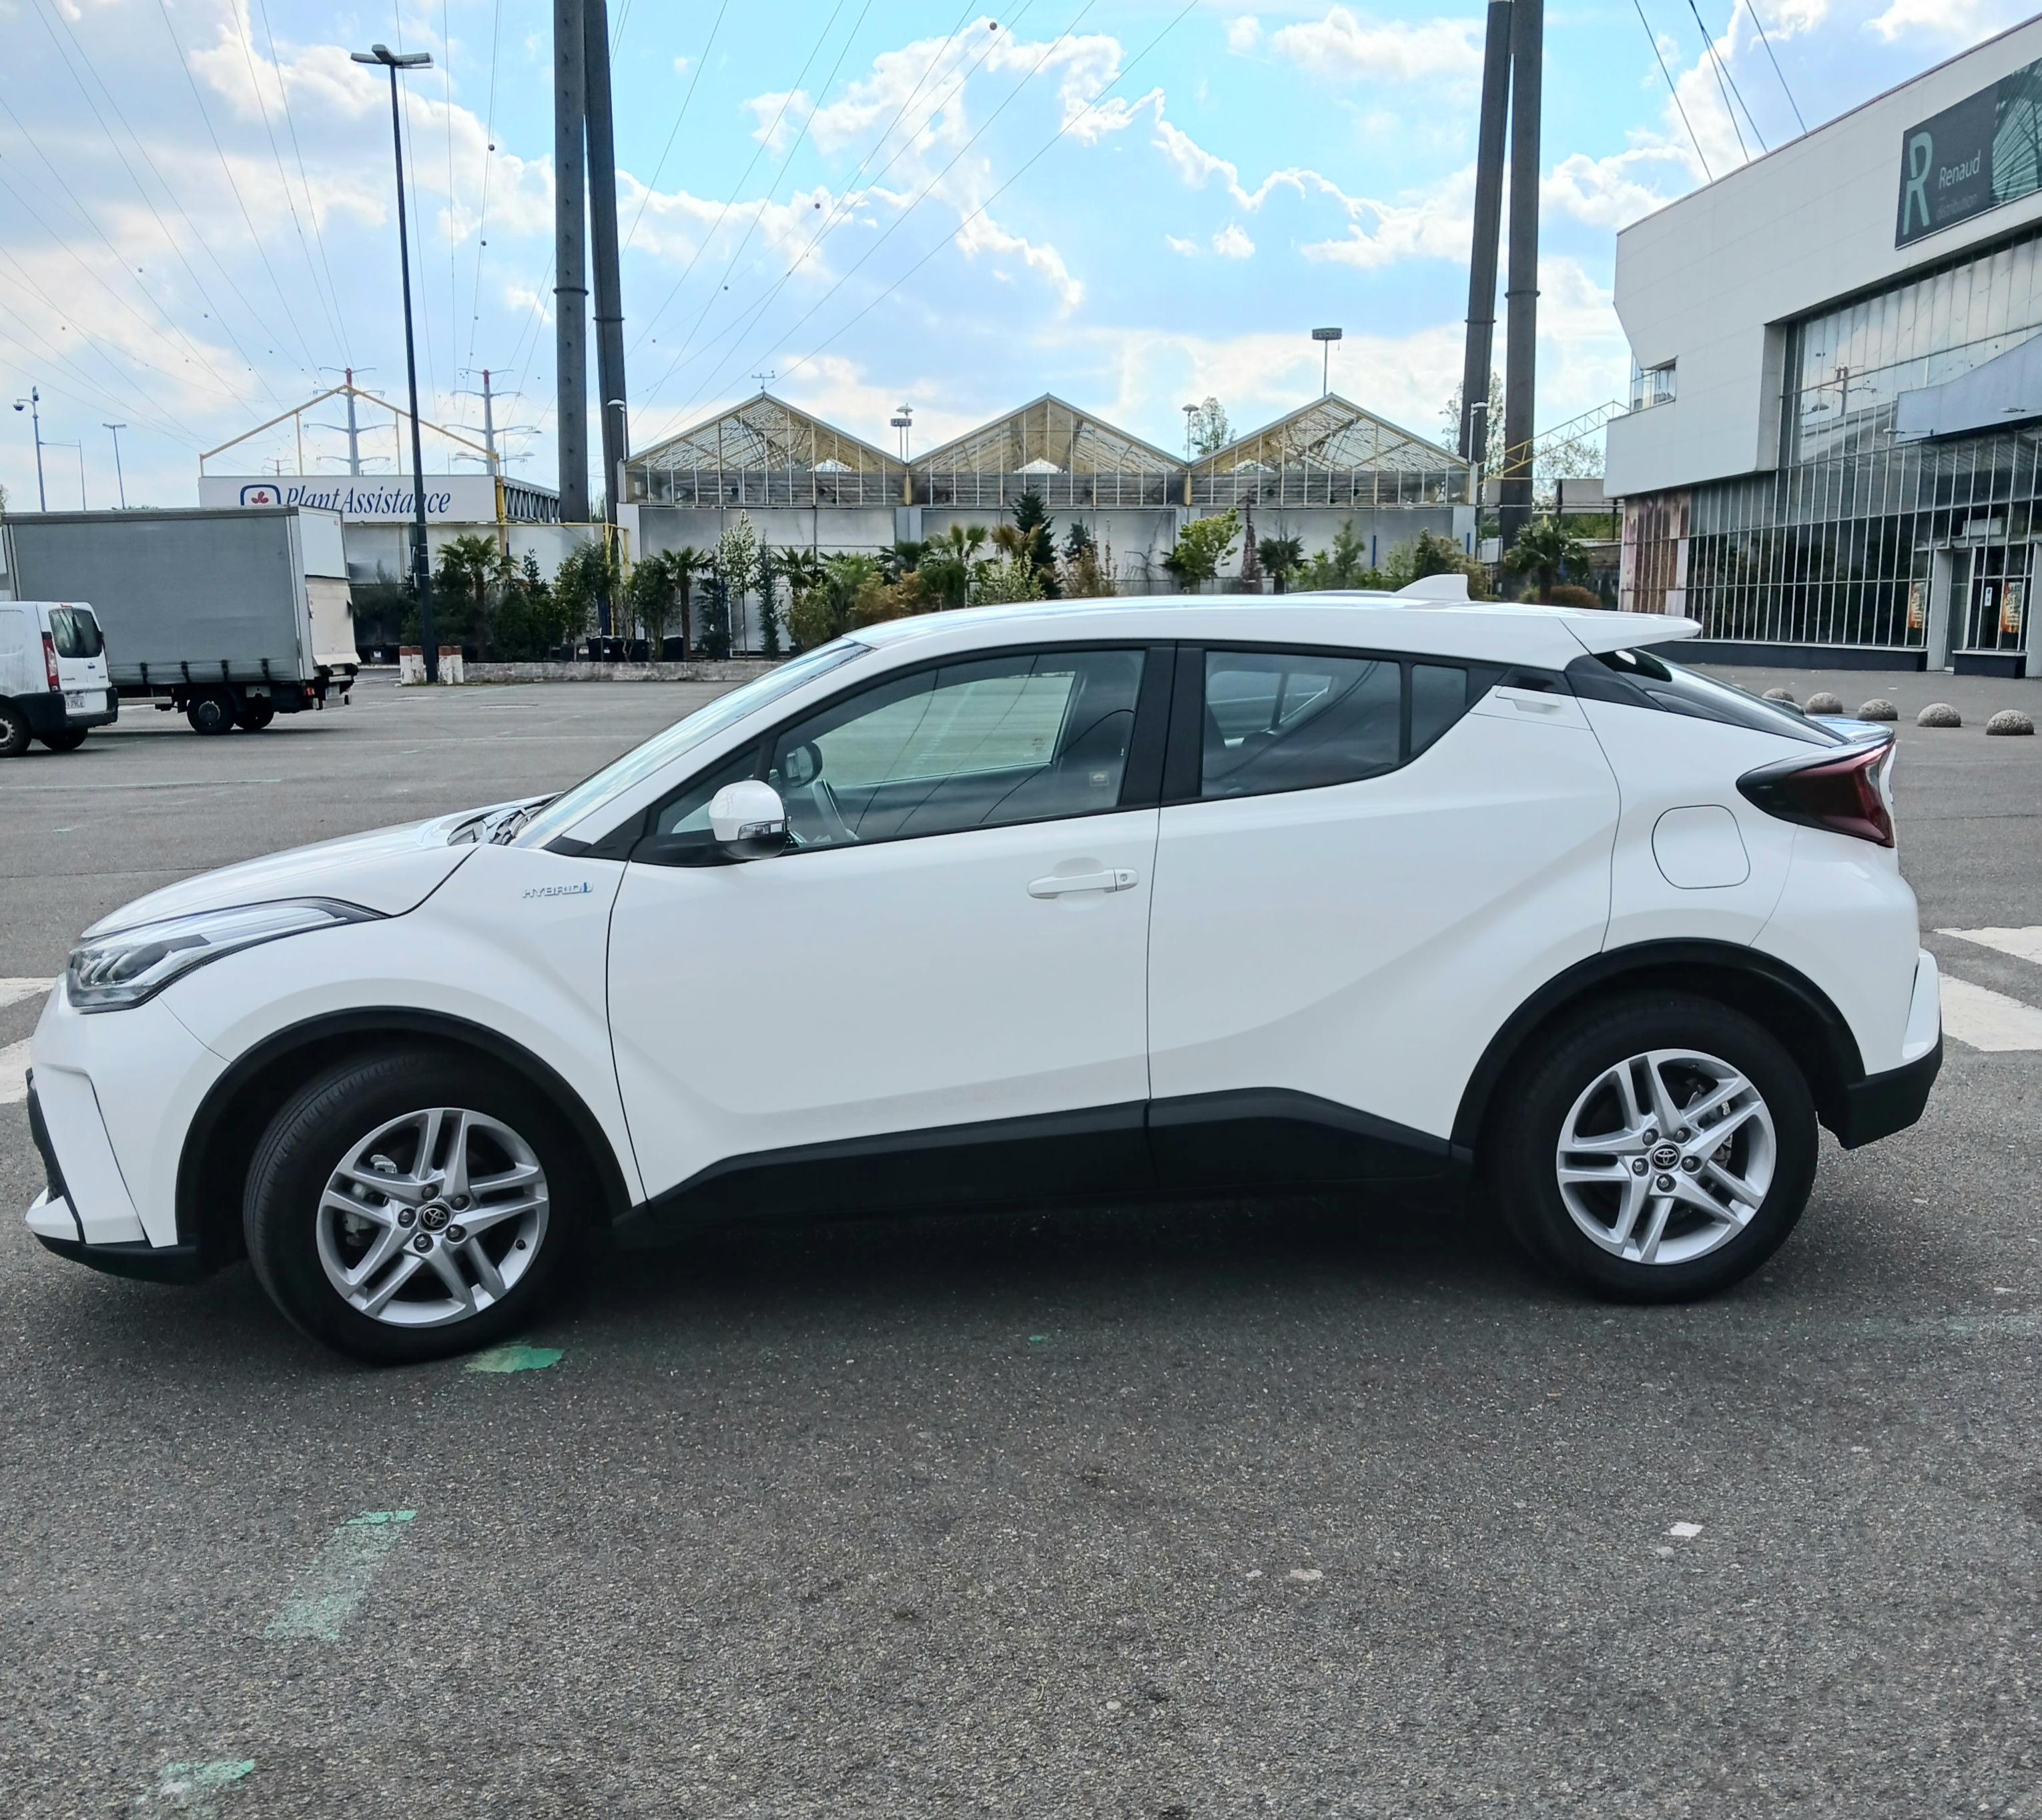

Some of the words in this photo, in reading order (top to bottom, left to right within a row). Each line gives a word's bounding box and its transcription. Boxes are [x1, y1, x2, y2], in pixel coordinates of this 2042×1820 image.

[1903, 131, 1933, 236] R
[1938, 149, 1981, 189] Renaud
[286, 485, 340, 511] Plant
[522, 884, 582, 899] HYBRID
